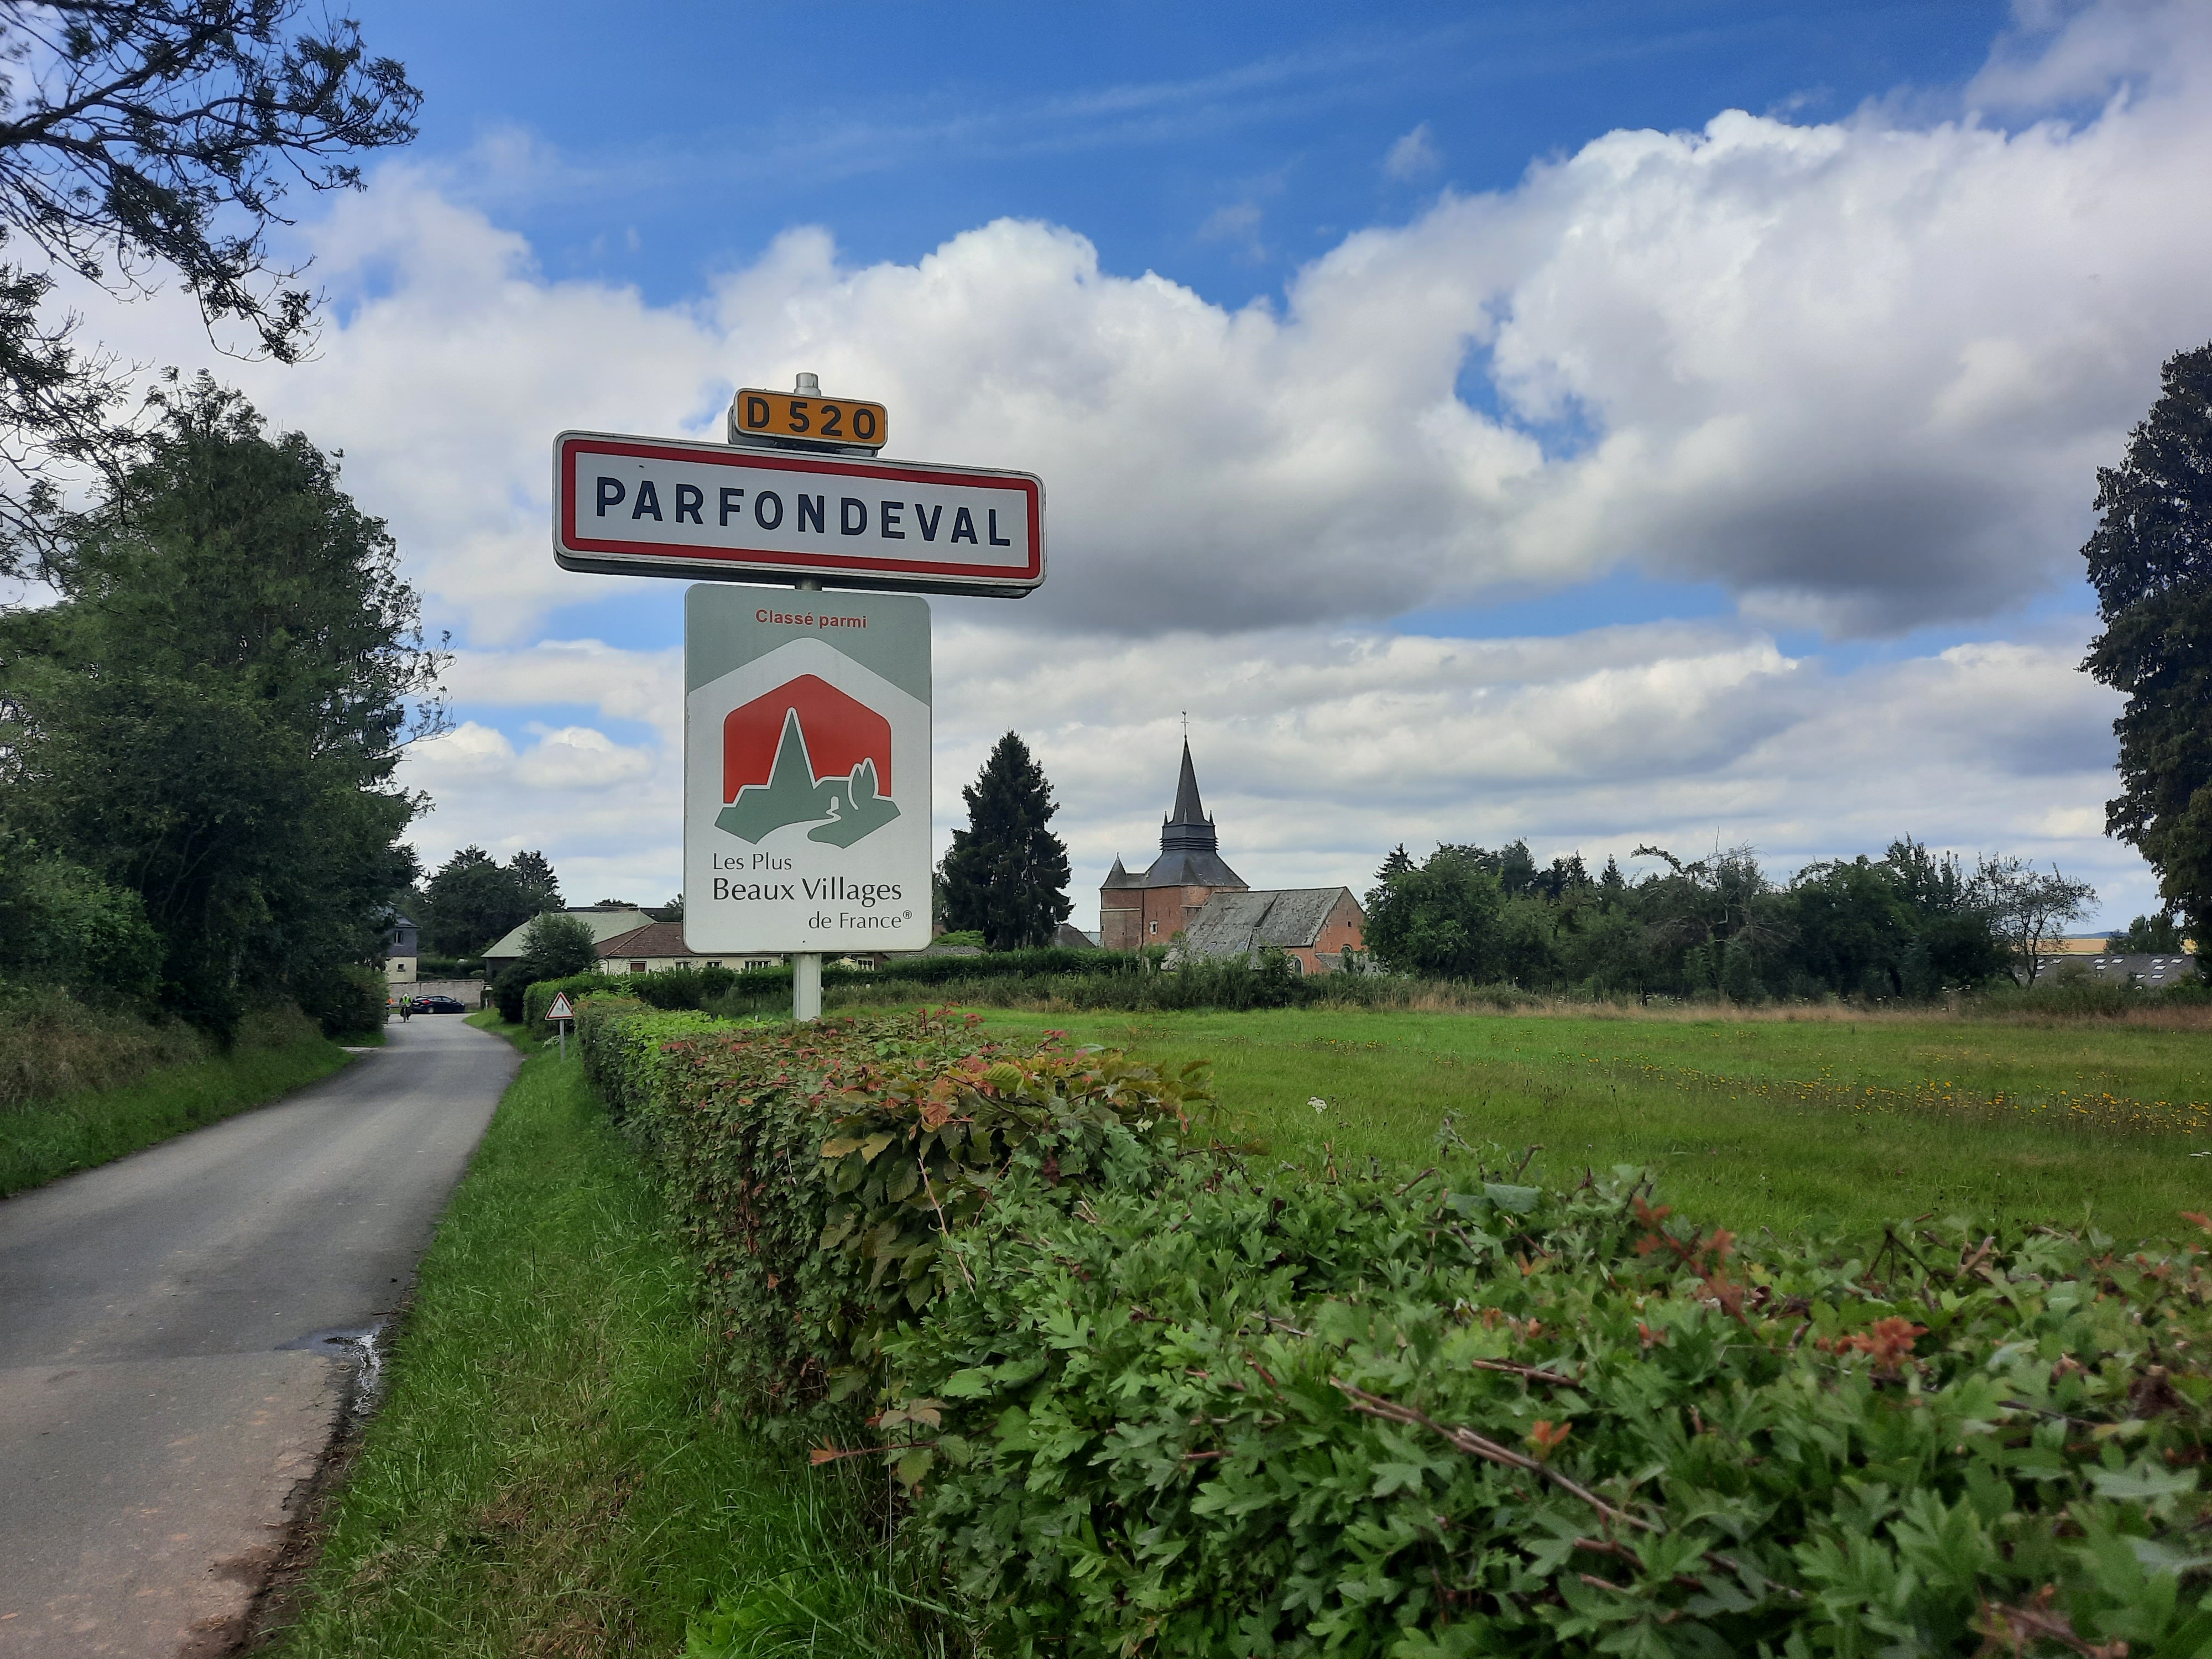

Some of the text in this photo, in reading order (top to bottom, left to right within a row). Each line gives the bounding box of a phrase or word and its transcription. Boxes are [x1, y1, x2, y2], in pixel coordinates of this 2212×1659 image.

[747, 396, 876, 440] D 520
[596, 476, 1010, 547] PARFONDEVAL
[755, 609, 867, 629] Classé parmi
[713, 852, 792, 871] Les Plus
[713, 876, 902, 907] Beaux Villages
[808, 910, 832, 929] de
